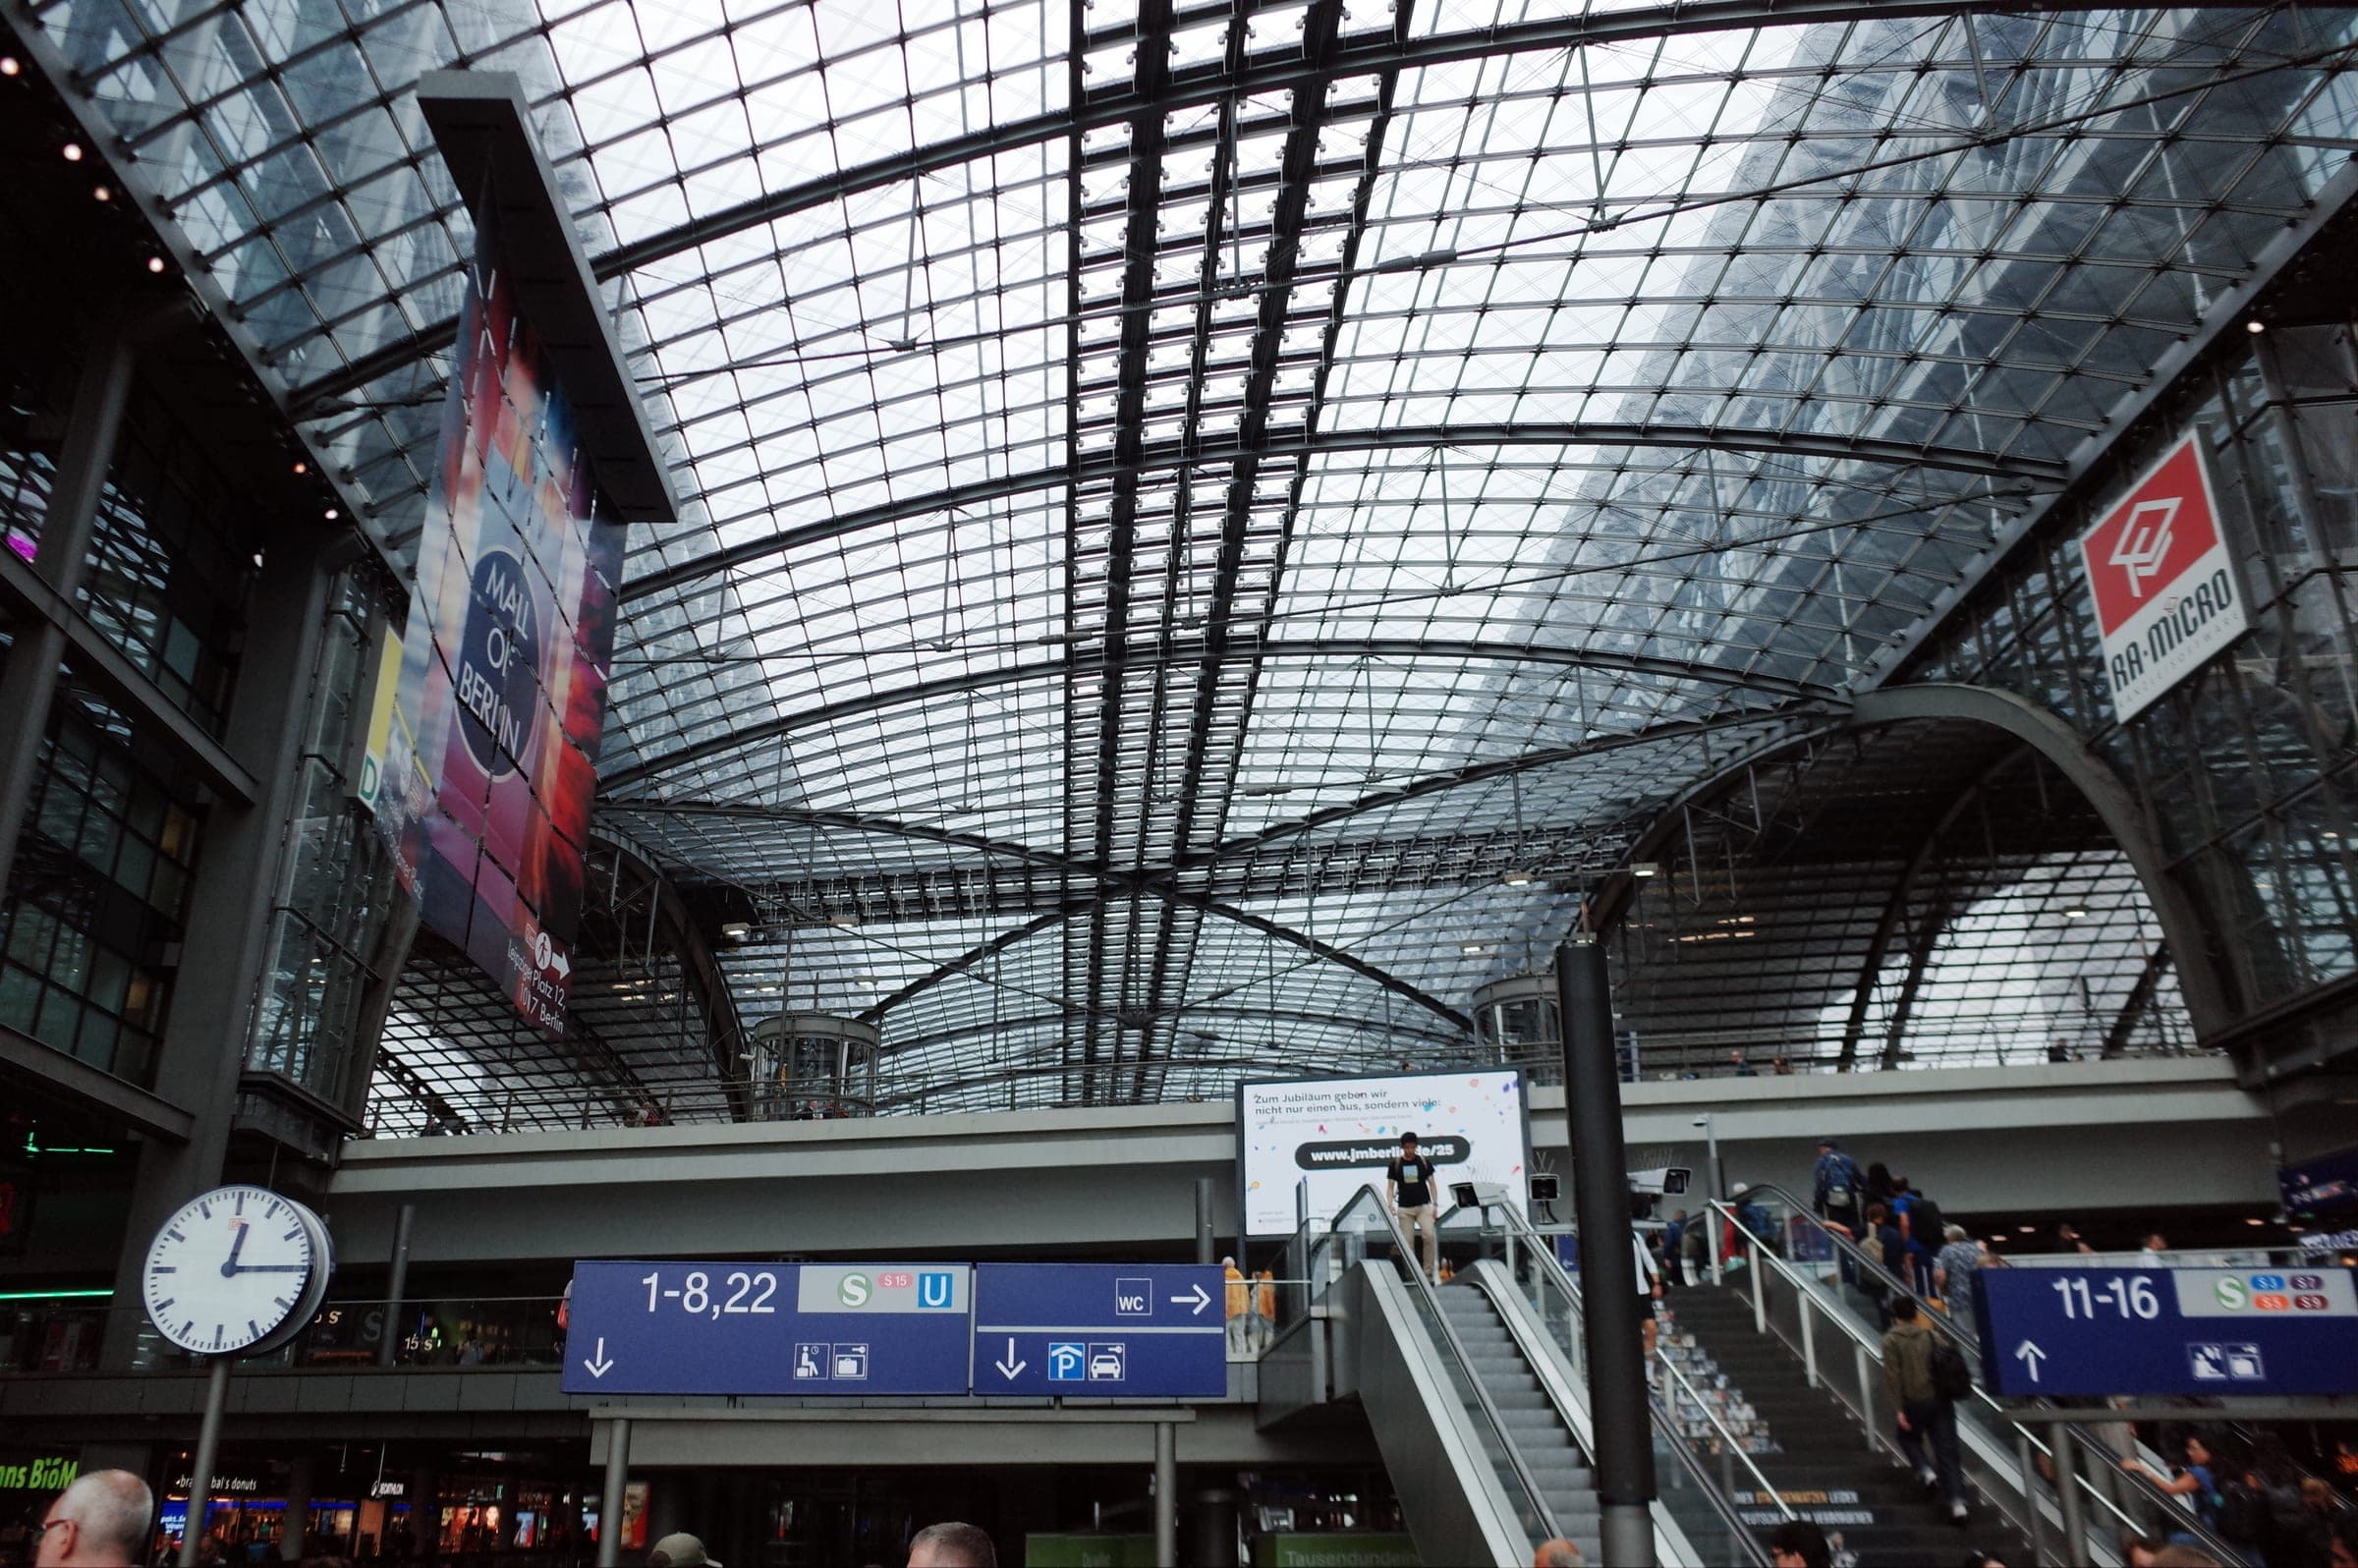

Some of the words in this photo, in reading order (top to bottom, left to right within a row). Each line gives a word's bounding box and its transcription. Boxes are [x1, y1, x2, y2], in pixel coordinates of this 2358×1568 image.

[484, 561, 531, 641] MALL
[458, 659, 521, 757] BERLIN
[532, 969, 553, 1000] Platz
[553, 983, 567, 1012] 12,
[539, 1002, 565, 1036] Berlin
[1255, 1093, 1279, 1104] Zum
[1281, 1091, 1332, 1103] Jubiläum
[1334, 1090, 1369, 1103] geben
[1370, 1088, 1388, 1099] wir
[1255, 1104, 1283, 1115] nicht
[1285, 1103, 1305, 1115] nur
[1306, 1102, 1337, 1113] einen
[1338, 1100, 1363, 1113] aus,
[1364, 1096, 1410, 1111] sondern
[642, 1270, 778, 1321] 1-8,22
[841, 1273, 869, 1307] S
[924, 1275, 947, 1307] U
[1118, 1296, 1145, 1313] WC
[2051, 1275, 2161, 1320] 11-16
[2217, 1276, 2248, 1310] S
[1057, 1353, 1076, 1379] P
[230, 1477, 257, 1491] donuts
